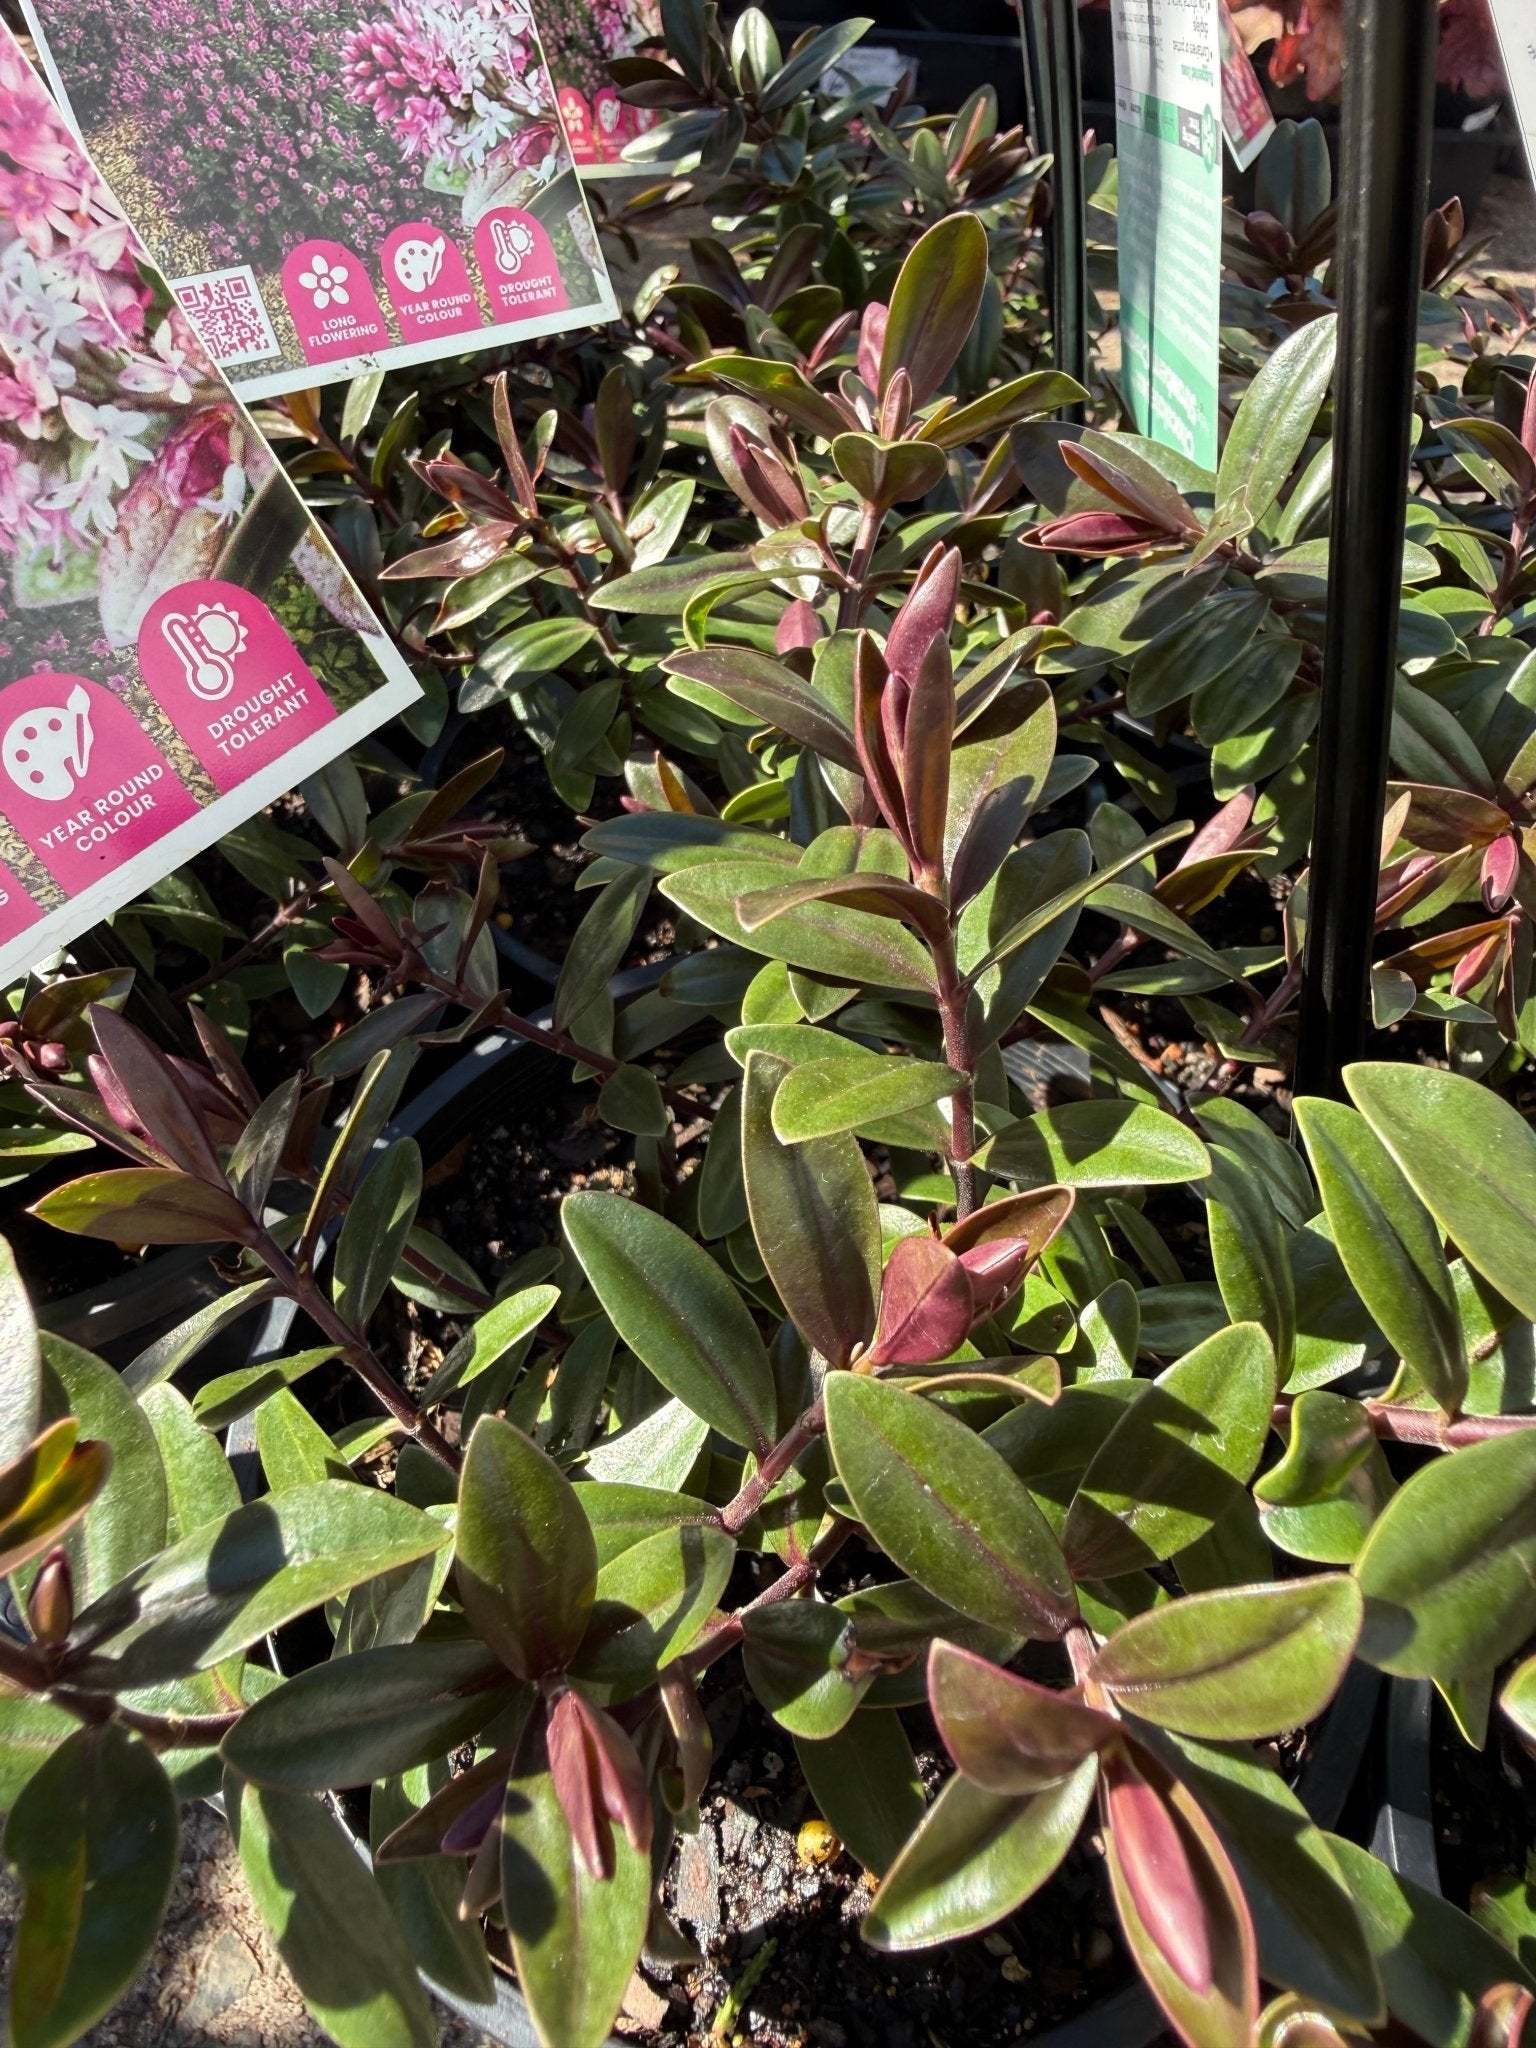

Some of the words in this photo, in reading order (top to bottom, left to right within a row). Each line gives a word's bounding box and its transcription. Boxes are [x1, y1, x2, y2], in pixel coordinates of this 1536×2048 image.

[498, 275, 553, 295] DROUGHT
[501, 286, 558, 308] TOLERANT
[399, 301, 430, 318] YEAR
[430, 293, 472, 310] ROUND
[416, 307, 463, 325] COLOUR
[308, 323, 378, 347] FLOWERING
[322, 315, 356, 331] LONG
[207, 673, 296, 740] DROUGHT
[216, 689, 309, 757] TOLERANT
[38, 810, 95, 849] YEAR
[94, 765, 163, 816] ROUND
[76, 794, 156, 852] COLOUR
